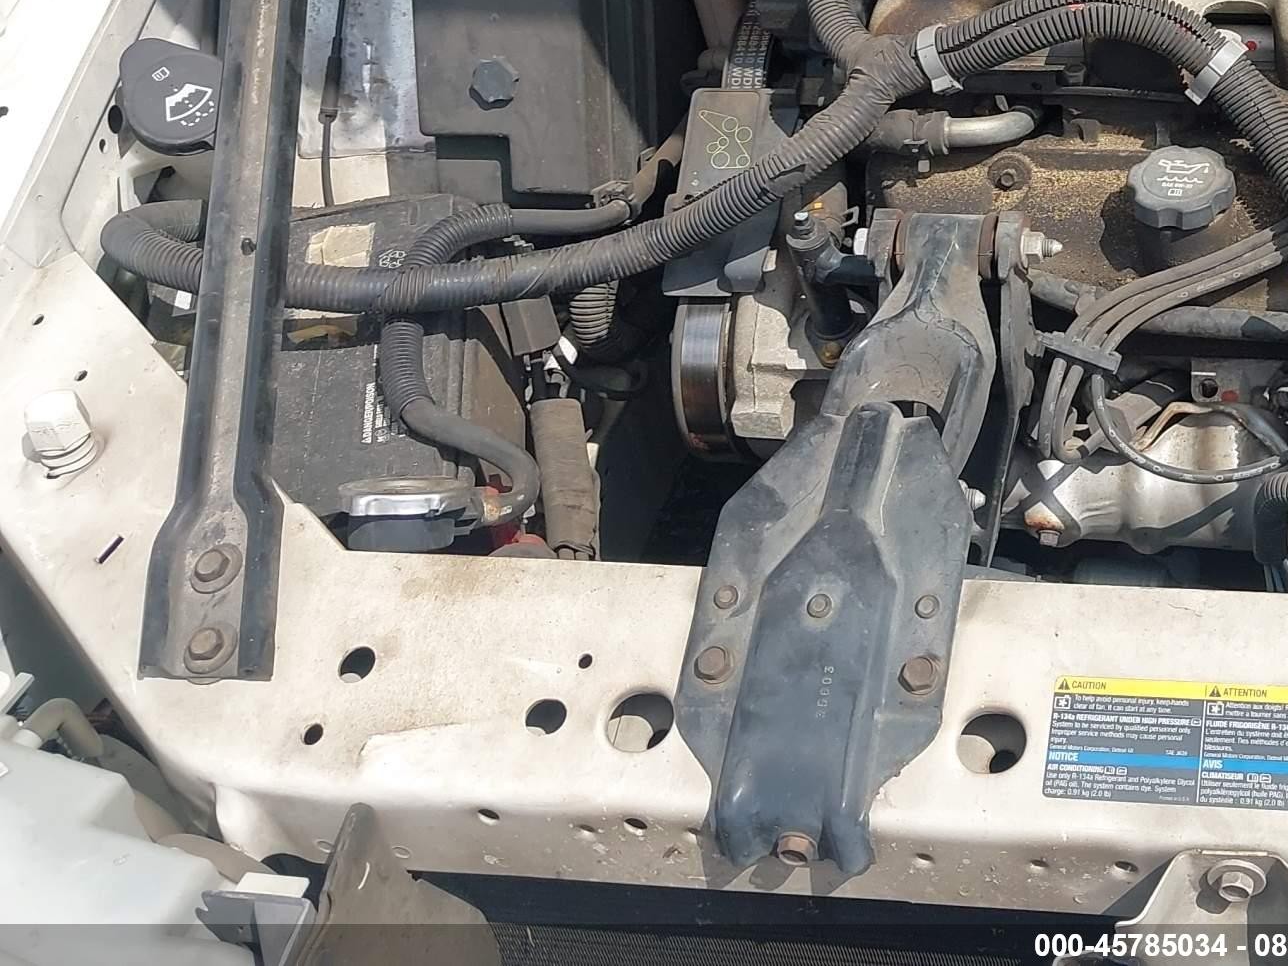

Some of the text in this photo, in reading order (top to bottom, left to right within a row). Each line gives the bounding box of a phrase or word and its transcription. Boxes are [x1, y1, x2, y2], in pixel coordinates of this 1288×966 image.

[1071, 680, 1106, 689] CAUTION
[1223, 688, 1267, 697] ATTENTION
[1112, 696, 1136, 704] personal
[1052, 712, 1190, 725] R-134a REFRIGERANT UNDER HIGH PRESSURE
[1051, 720, 1073, 728] System
[1090, 722, 1114, 730] serviced
[1123, 724, 1148, 732] qualified
[1149, 725, 1177, 733] personnel
[1205, 719, 1227, 727] FLUIDE
[1229, 720, 1269, 729] FRIGORIGÈNE
[1051, 728, 1076, 736] Improper
[1077, 729, 1098, 737] service
[1157, 733, 1182, 741] personal
[1270, 731, 1282, 739] doit
[1048, 751, 1079, 761] NOTICE
[1059, 763, 1104, 773] CONDITIONING
[1202, 759, 1223, 769] AVIS
[1046, 771, 1194, 786] Use only R-134a Refrigerant and Polyalkylene Glycol
[1201, 771, 1243, 780] CLIMATISEUR
[1053, 780, 1067, 788] (PAG
[1080, 781, 1092, 790] The
[1092, 782, 1114, 791] system
[1114, 783, 1139, 792] contains
[1140, 784, 1152, 793] dye.
[1154, 785, 1176, 794] System
[1201, 779, 1221, 788] Utiliser
[1222, 780, 1252, 789] seulement
[1253, 782, 1260, 790] le
[1044, 787, 1111, 798] charge: 0.91 kg (2.0 lb)
[1199, 795, 1207, 803] du
[1239, 797, 1252, 806] 0.91
[1254, 798, 1262, 806] kg
[1263, 799, 1275, 807] (2.0
[1276, 799, 1284, 807] lb)
